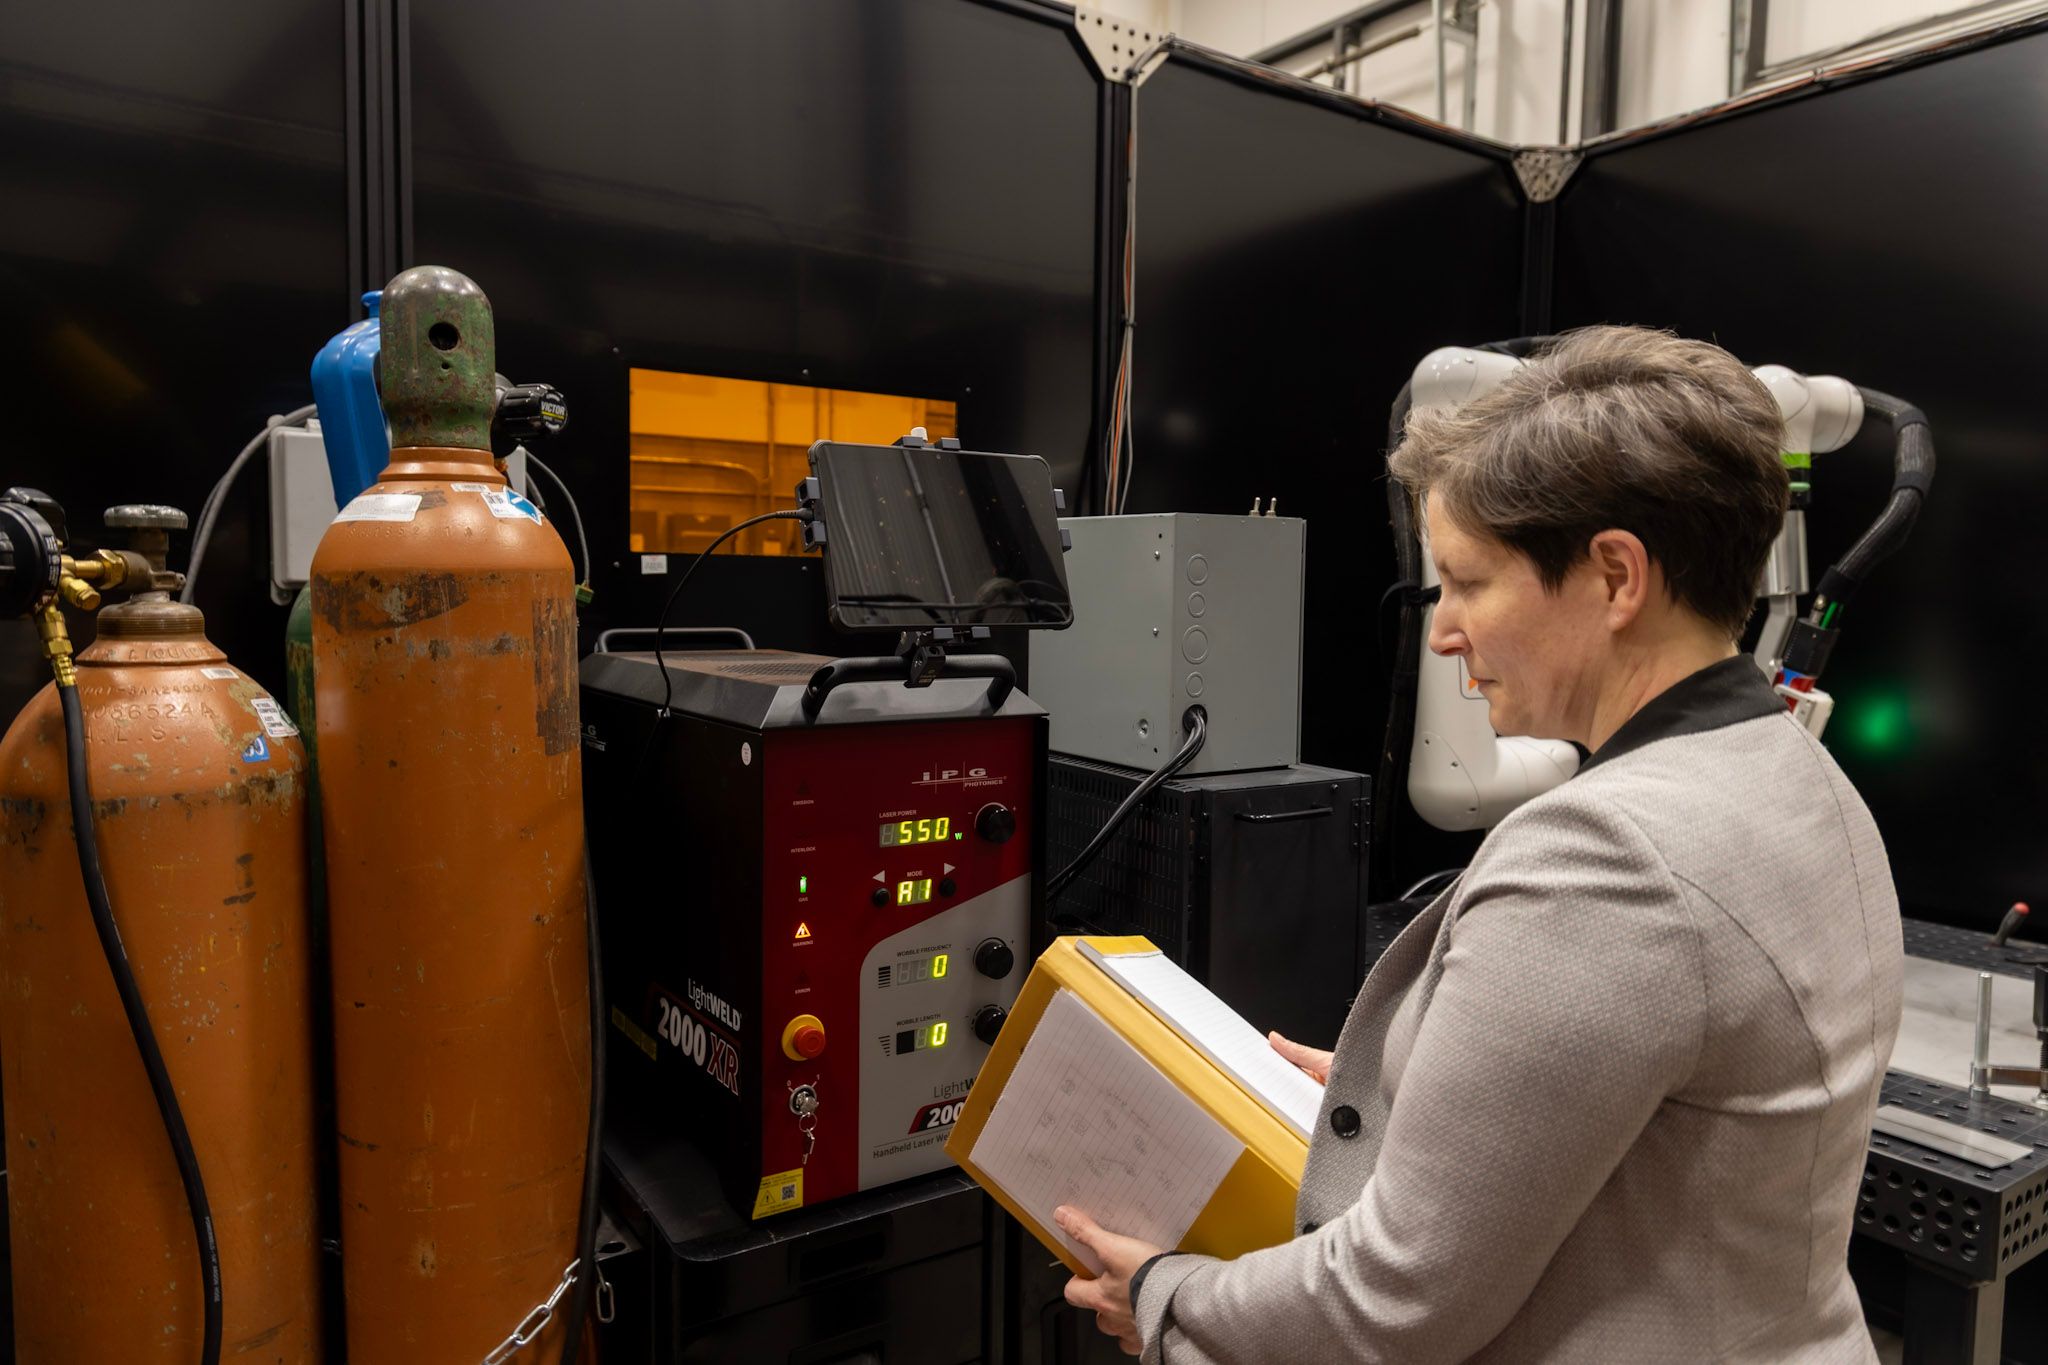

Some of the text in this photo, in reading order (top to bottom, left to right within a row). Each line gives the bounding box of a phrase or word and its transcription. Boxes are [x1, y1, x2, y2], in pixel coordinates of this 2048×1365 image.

[541, 401, 565, 415] VICTOR
[922, 767, 987, 781] IPG
[964, 779, 1003, 788] PHOTONICS
[899, 817, 963, 843] 550 W
[898, 879, 932, 903] A1
[896, 944, 952, 957] WOBBLE FREQUENCY
[933, 954, 948, 978] 0
[688, 978, 741, 1032] LightWELD
[896, 1014, 941, 1027] WOBBLE LENGTH
[932, 1022, 948, 1046] 0
[657, 997, 706, 1066] 2000
[707, 1031, 739, 1096] XR
[873, 1141, 912, 1158] Handheld
[913, 1137, 934, 1149] Laser
